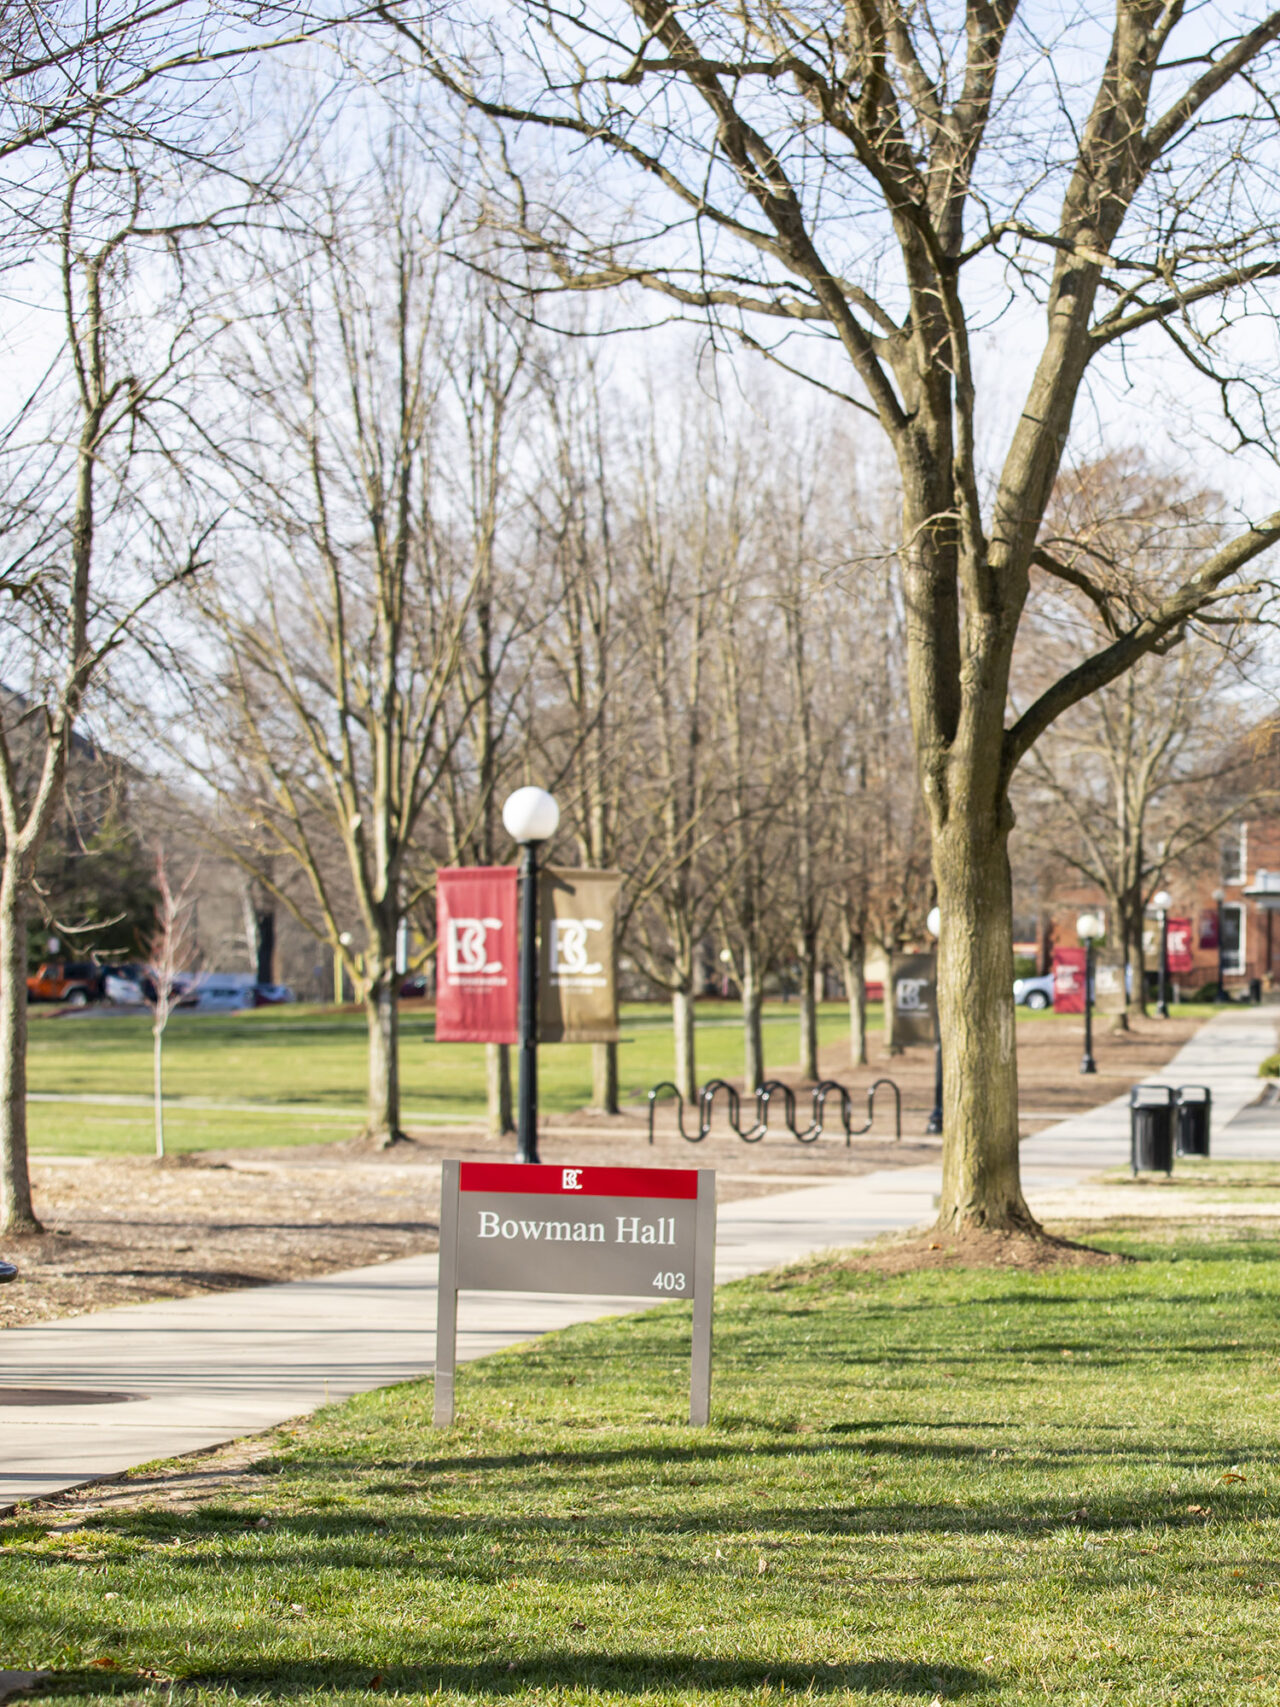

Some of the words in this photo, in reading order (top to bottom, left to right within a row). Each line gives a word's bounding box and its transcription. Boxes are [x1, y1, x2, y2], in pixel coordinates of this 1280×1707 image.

[447, 918, 503, 974] BC
[550, 918, 604, 975] BC
[562, 1169, 583, 1189] BC
[477, 1211, 605, 1243] Bowman
[615, 1216, 676, 1245] Hall
[652, 1272, 686, 1291] 403
